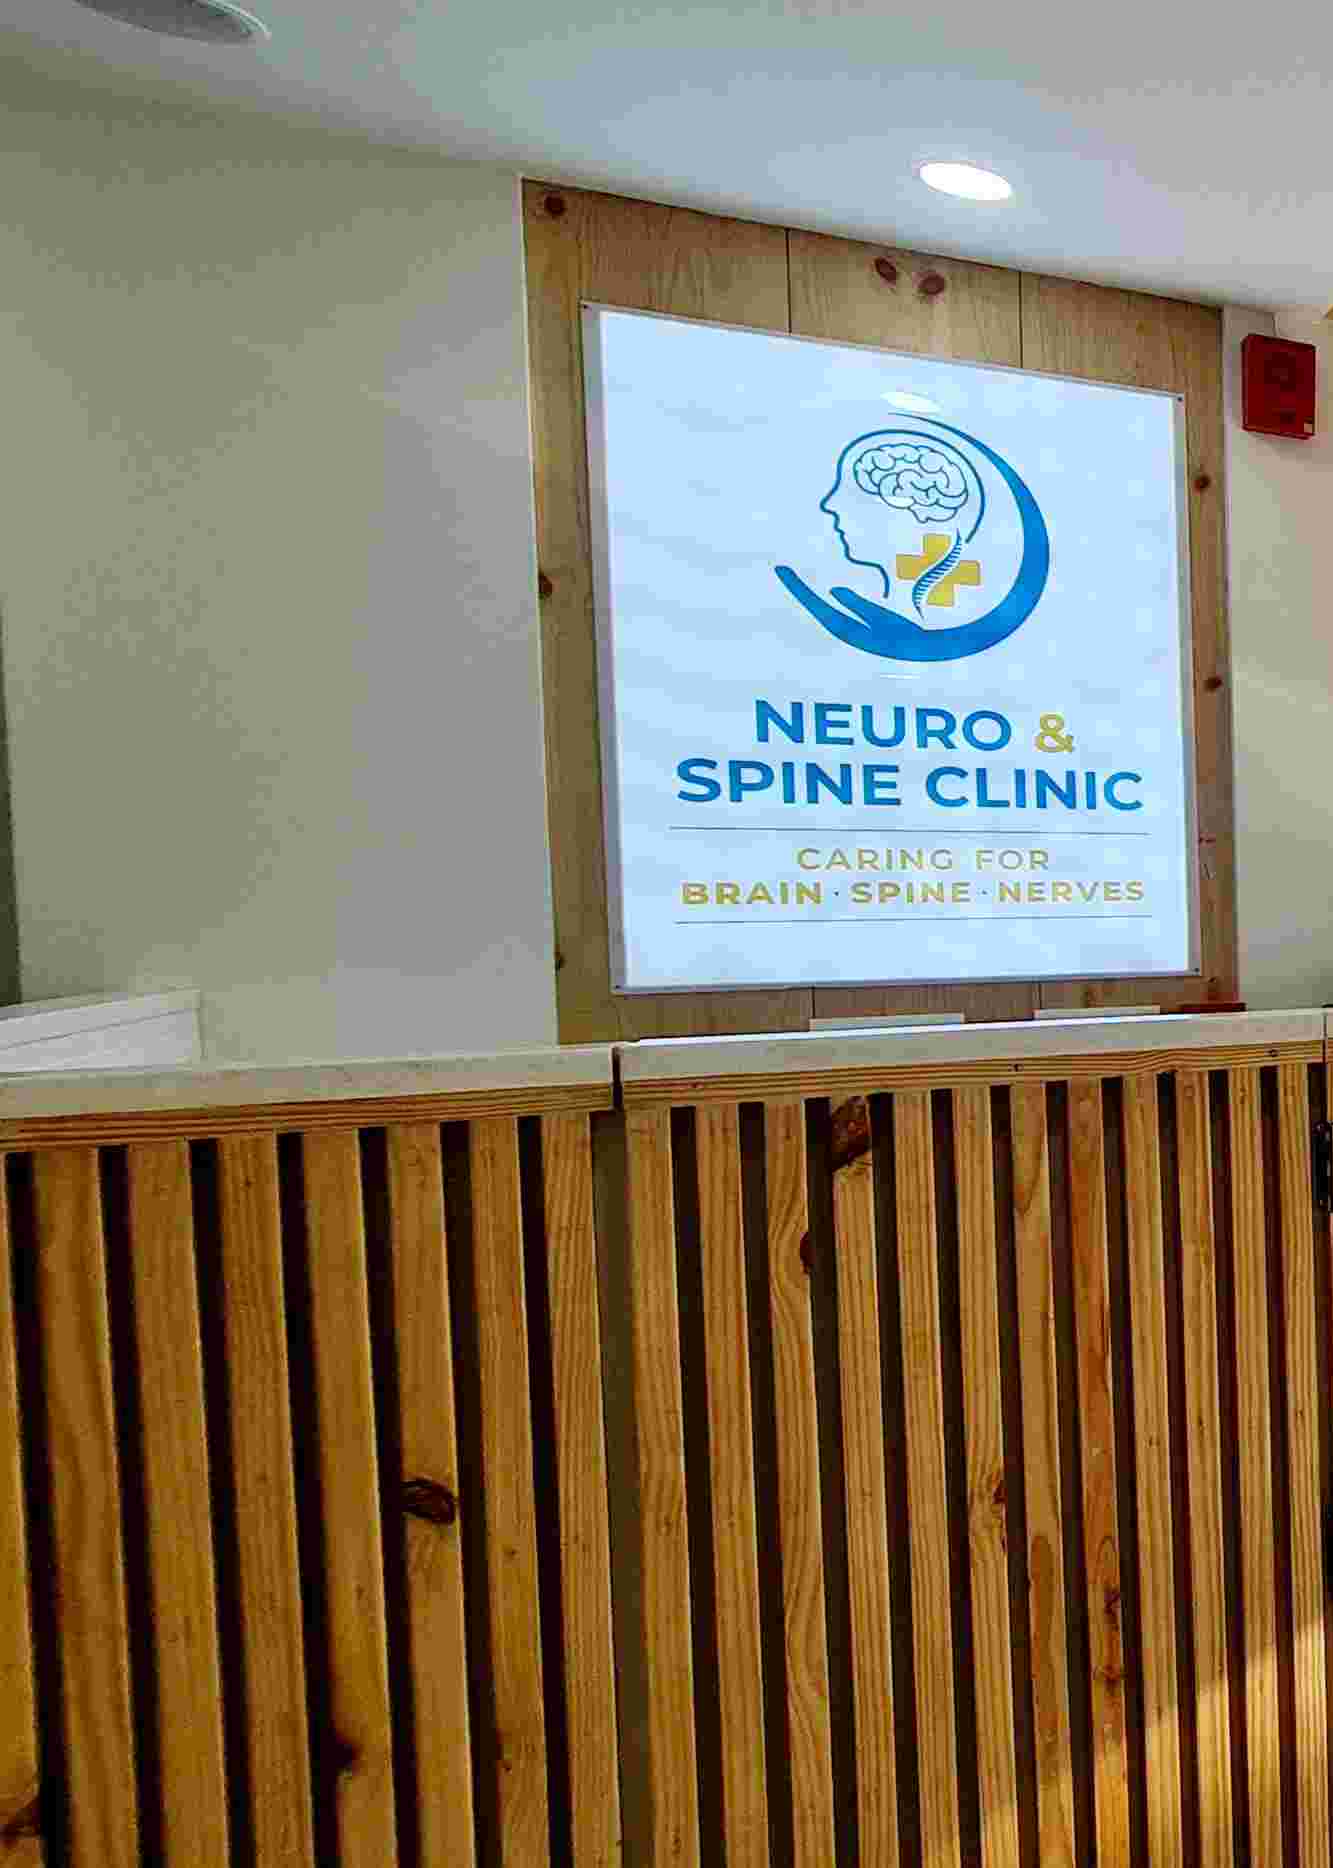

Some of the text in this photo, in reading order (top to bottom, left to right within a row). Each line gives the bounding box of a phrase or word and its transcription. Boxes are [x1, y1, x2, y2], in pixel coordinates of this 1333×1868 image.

[755, 699, 1075, 754] NEURO &
[676, 757, 1143, 811] SPINE CLINIC
[796, 847, 1050, 871] CARING FOR
[680, 880, 1145, 906] BRAIN SPINE NERVES
